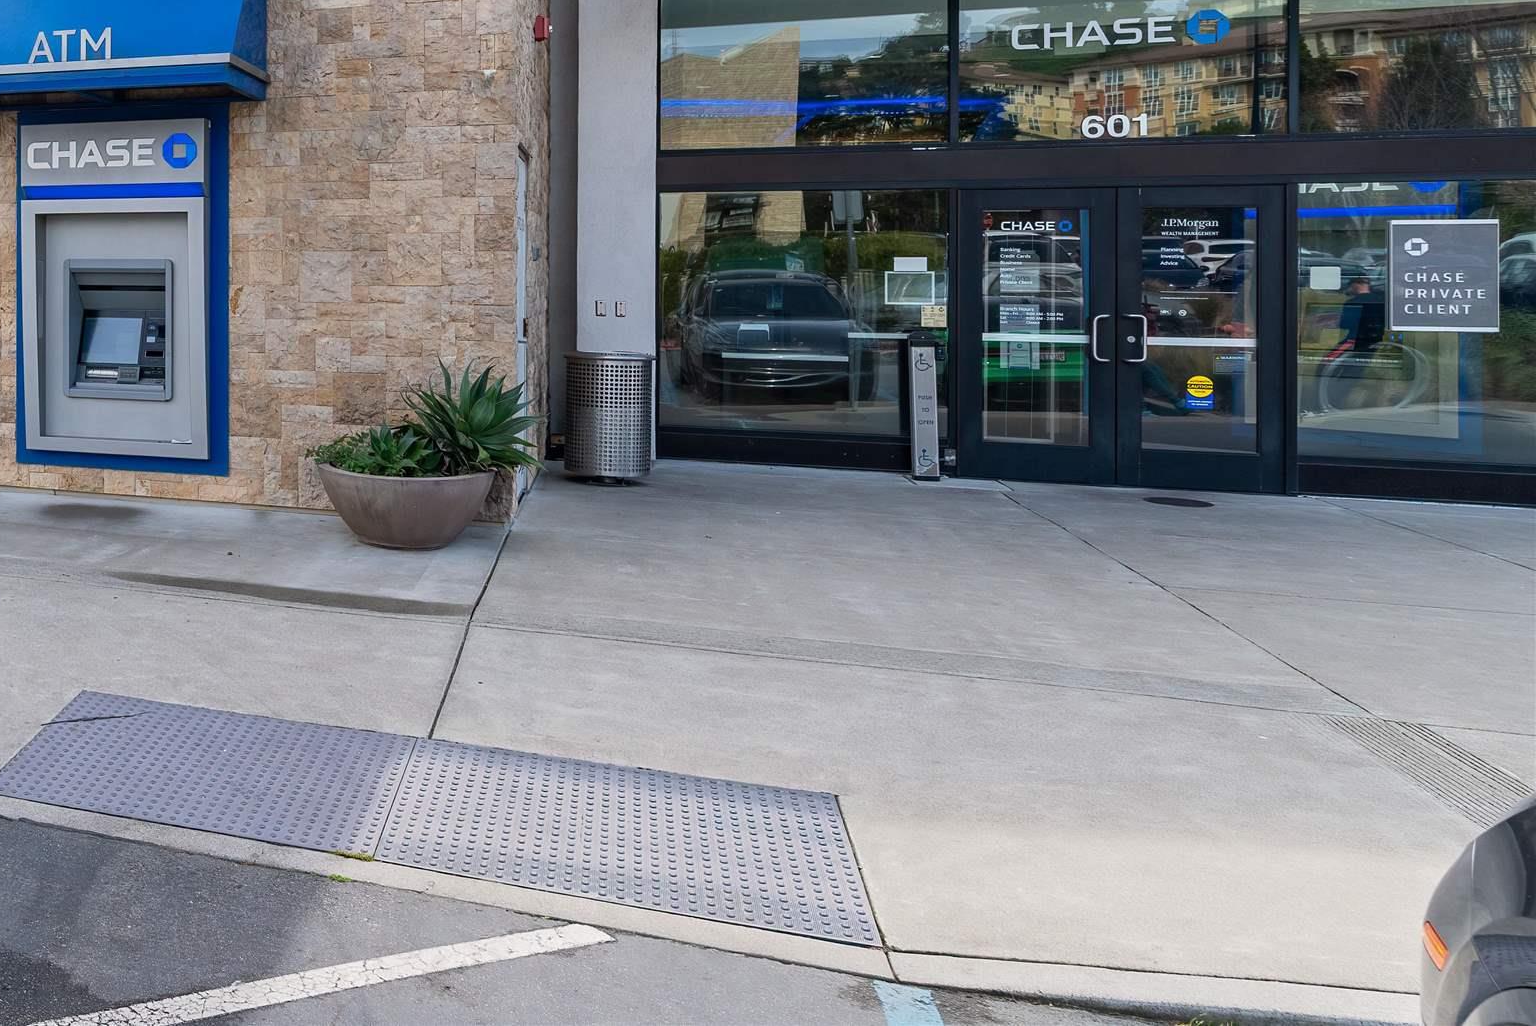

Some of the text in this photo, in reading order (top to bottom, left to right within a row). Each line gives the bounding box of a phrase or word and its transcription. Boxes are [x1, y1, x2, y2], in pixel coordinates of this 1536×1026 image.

[1011, 15, 1177, 50] CHASE
[28, 26, 113, 64] ATM
[1081, 113, 1148, 139] 601
[27, 137, 156, 170] CHASE
[1000, 221, 1056, 231] CHASE
[1404, 272, 1465, 283] CHASE
[1404, 288, 1487, 299] PRIVATE
[1404, 304, 1472, 315] CLIENT
